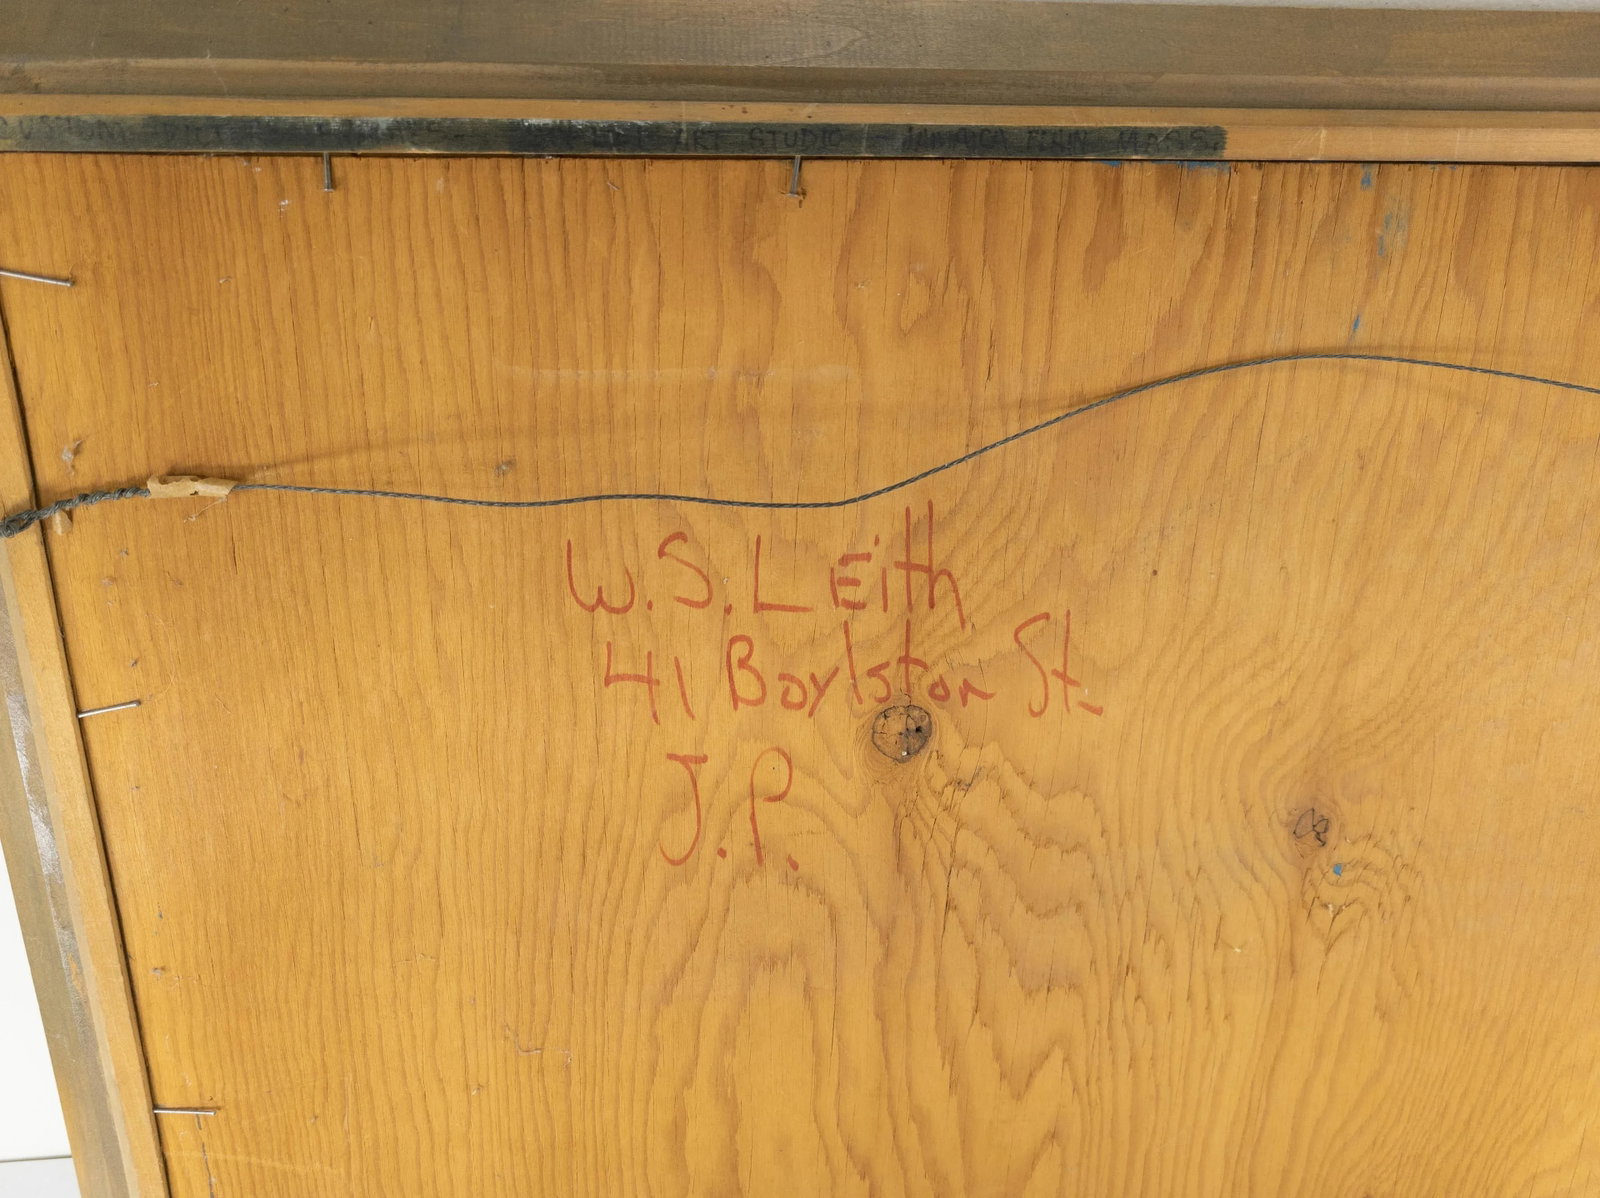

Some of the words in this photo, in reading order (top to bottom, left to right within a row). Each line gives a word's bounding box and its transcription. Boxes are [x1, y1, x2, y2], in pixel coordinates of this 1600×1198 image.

[748, 126, 843, 153] STUDIO
[602, 640, 696, 726] 41
[725, 619, 997, 719] Boylston
